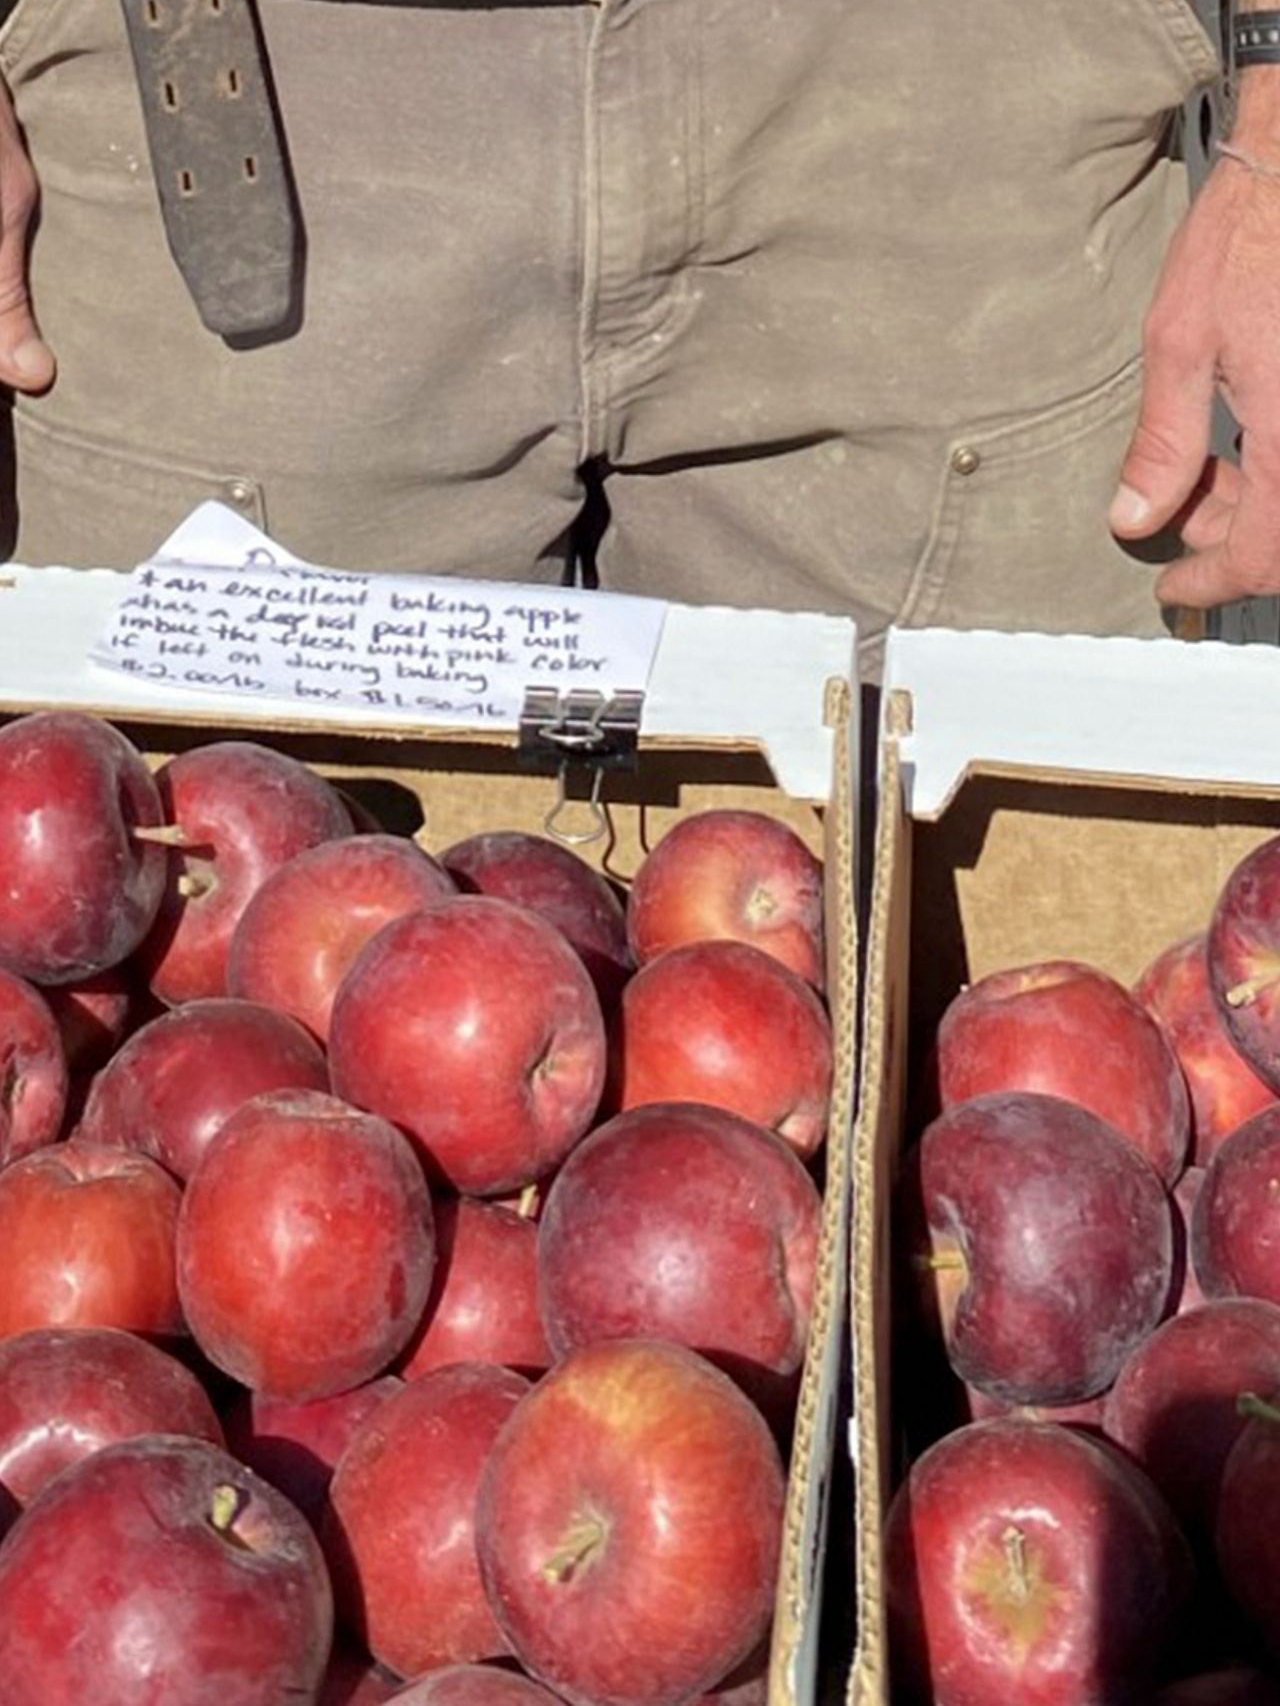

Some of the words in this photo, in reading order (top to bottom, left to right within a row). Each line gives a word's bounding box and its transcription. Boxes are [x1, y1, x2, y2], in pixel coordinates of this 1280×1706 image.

[164, 576, 207, 593] an
[218, 580, 369, 606] excellent
[390, 592, 490, 630] baking
[503, 604, 583, 633] apple
[119, 614, 202, 637] imbue
[207, 624, 258, 644] the
[270, 629, 356, 653] flesh
[444, 647, 518, 668] pink
[530, 653, 607, 672] color
[372, 620, 428, 643] peel
[437, 626, 508, 643] that
[523, 634, 580, 650] will
[159, 639, 210, 656] left
[227, 651, 262, 666] on
[285, 651, 380, 686] during
[396, 661, 489, 694] baking
[294, 679, 342, 700] box
